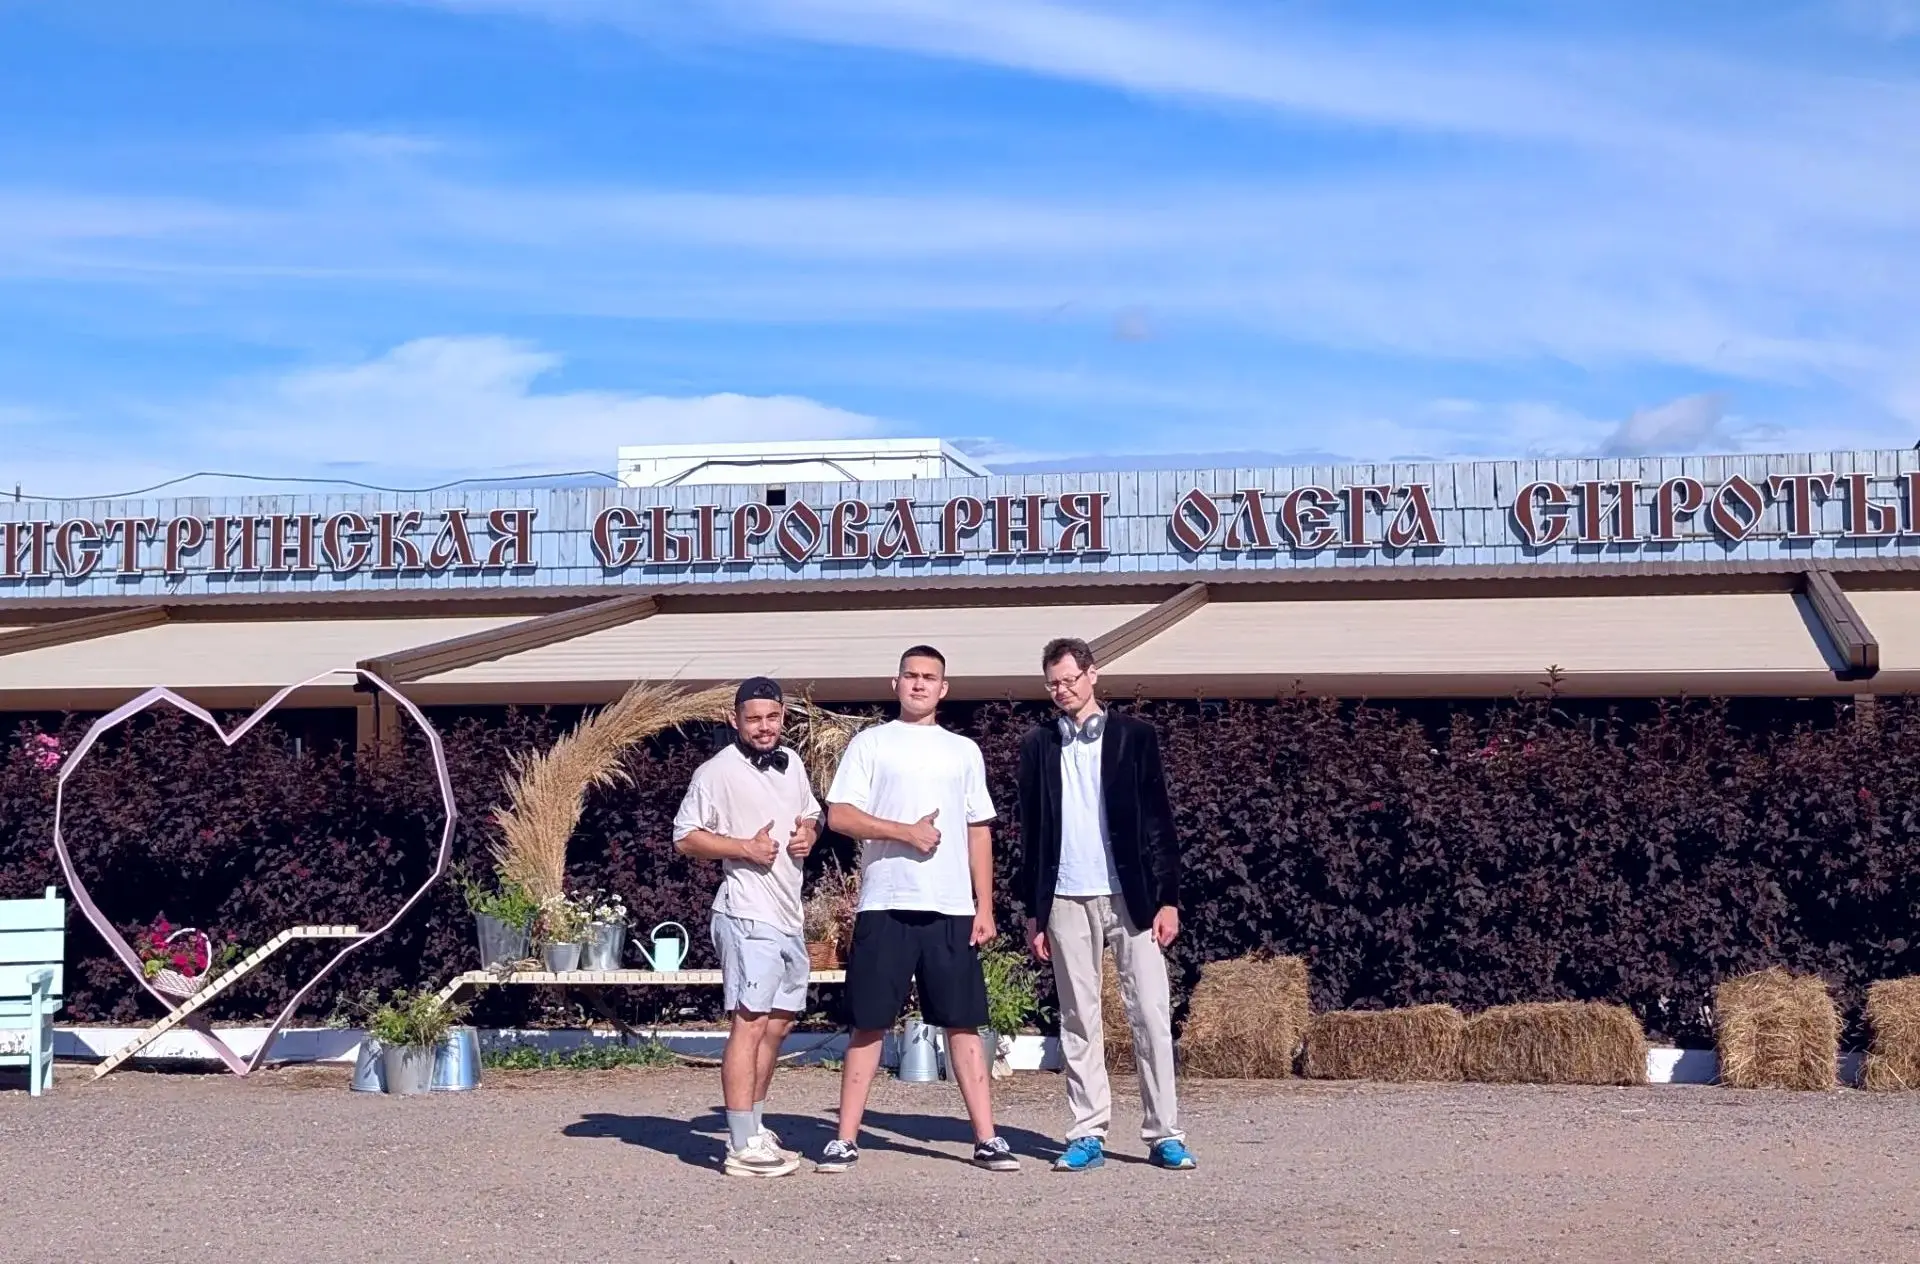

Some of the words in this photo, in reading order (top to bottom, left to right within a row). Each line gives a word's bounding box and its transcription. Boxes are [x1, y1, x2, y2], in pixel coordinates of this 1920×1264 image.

[0, 507, 537, 578] ИСТРИНСКАЯ
[591, 491, 1110, 567] СЫРОВАРНЯ
[1171, 483, 1446, 552] ОЛЕГА
